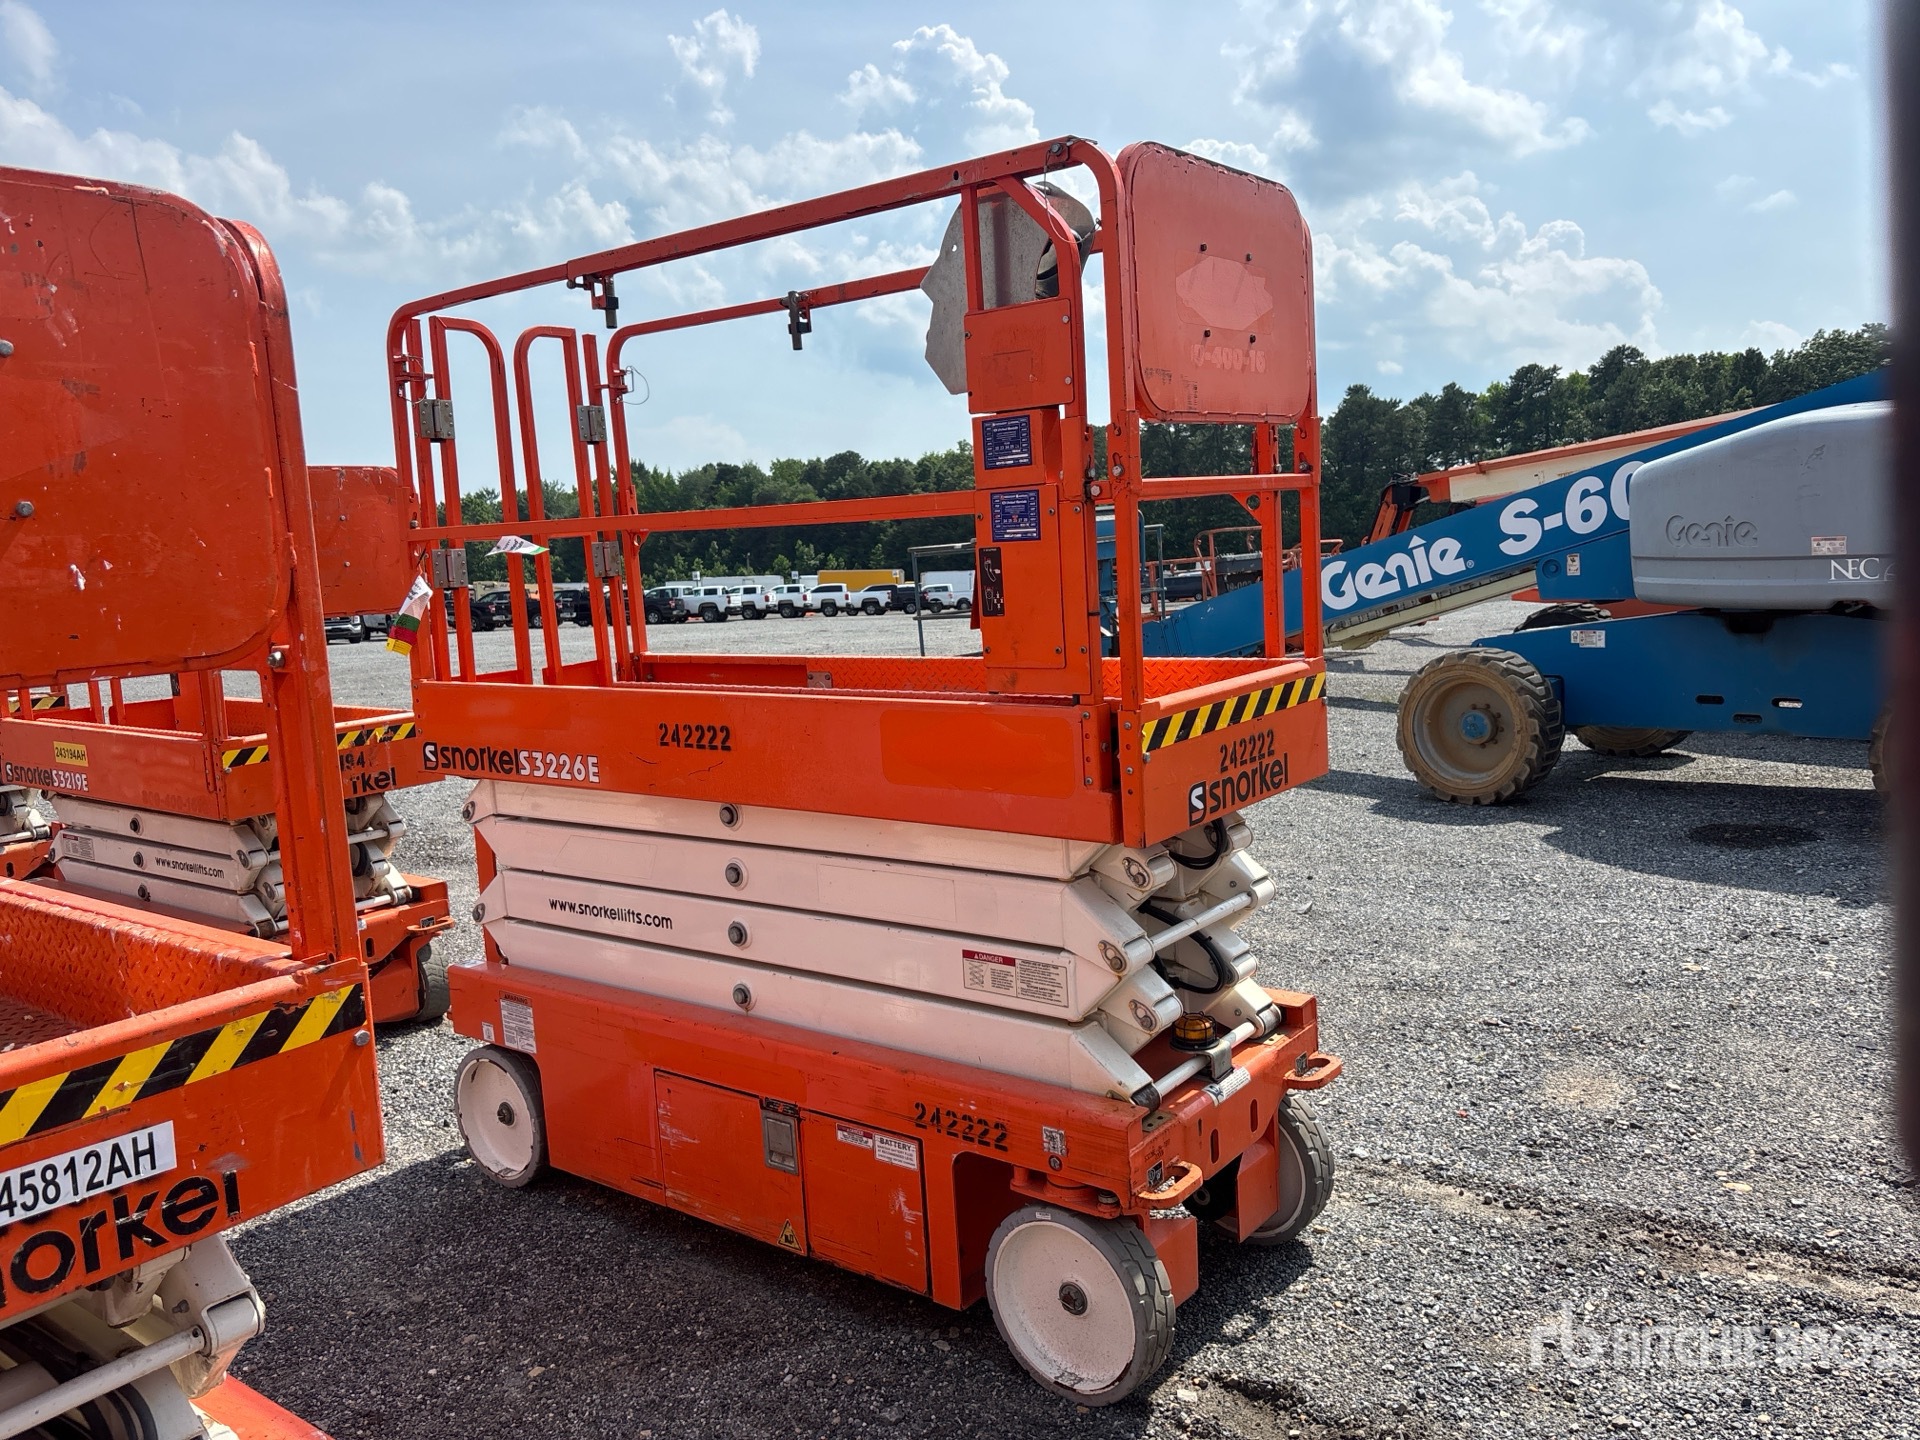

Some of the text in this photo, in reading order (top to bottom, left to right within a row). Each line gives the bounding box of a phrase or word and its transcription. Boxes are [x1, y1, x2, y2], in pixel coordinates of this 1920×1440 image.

[1666, 515, 1758, 547] Genie
[1829, 557, 1880, 581] NEC
[658, 722, 732, 751] 242222
[1219, 729, 1275, 773] 242222
[55, 746, 87, 761] 243194AH
[519, 750, 600, 783] S3226E
[52, 769, 89, 792] S3219E
[1209, 752, 1289, 815] snorkel
[155, 856, 224, 878] www.snorkellifts.com
[549, 899, 673, 929] www.snorkellifts.com
[979, 953, 1004, 964] DANGER
[914, 1102, 1009, 1152] 242222
[879, 1137, 912, 1151] BATTERY
